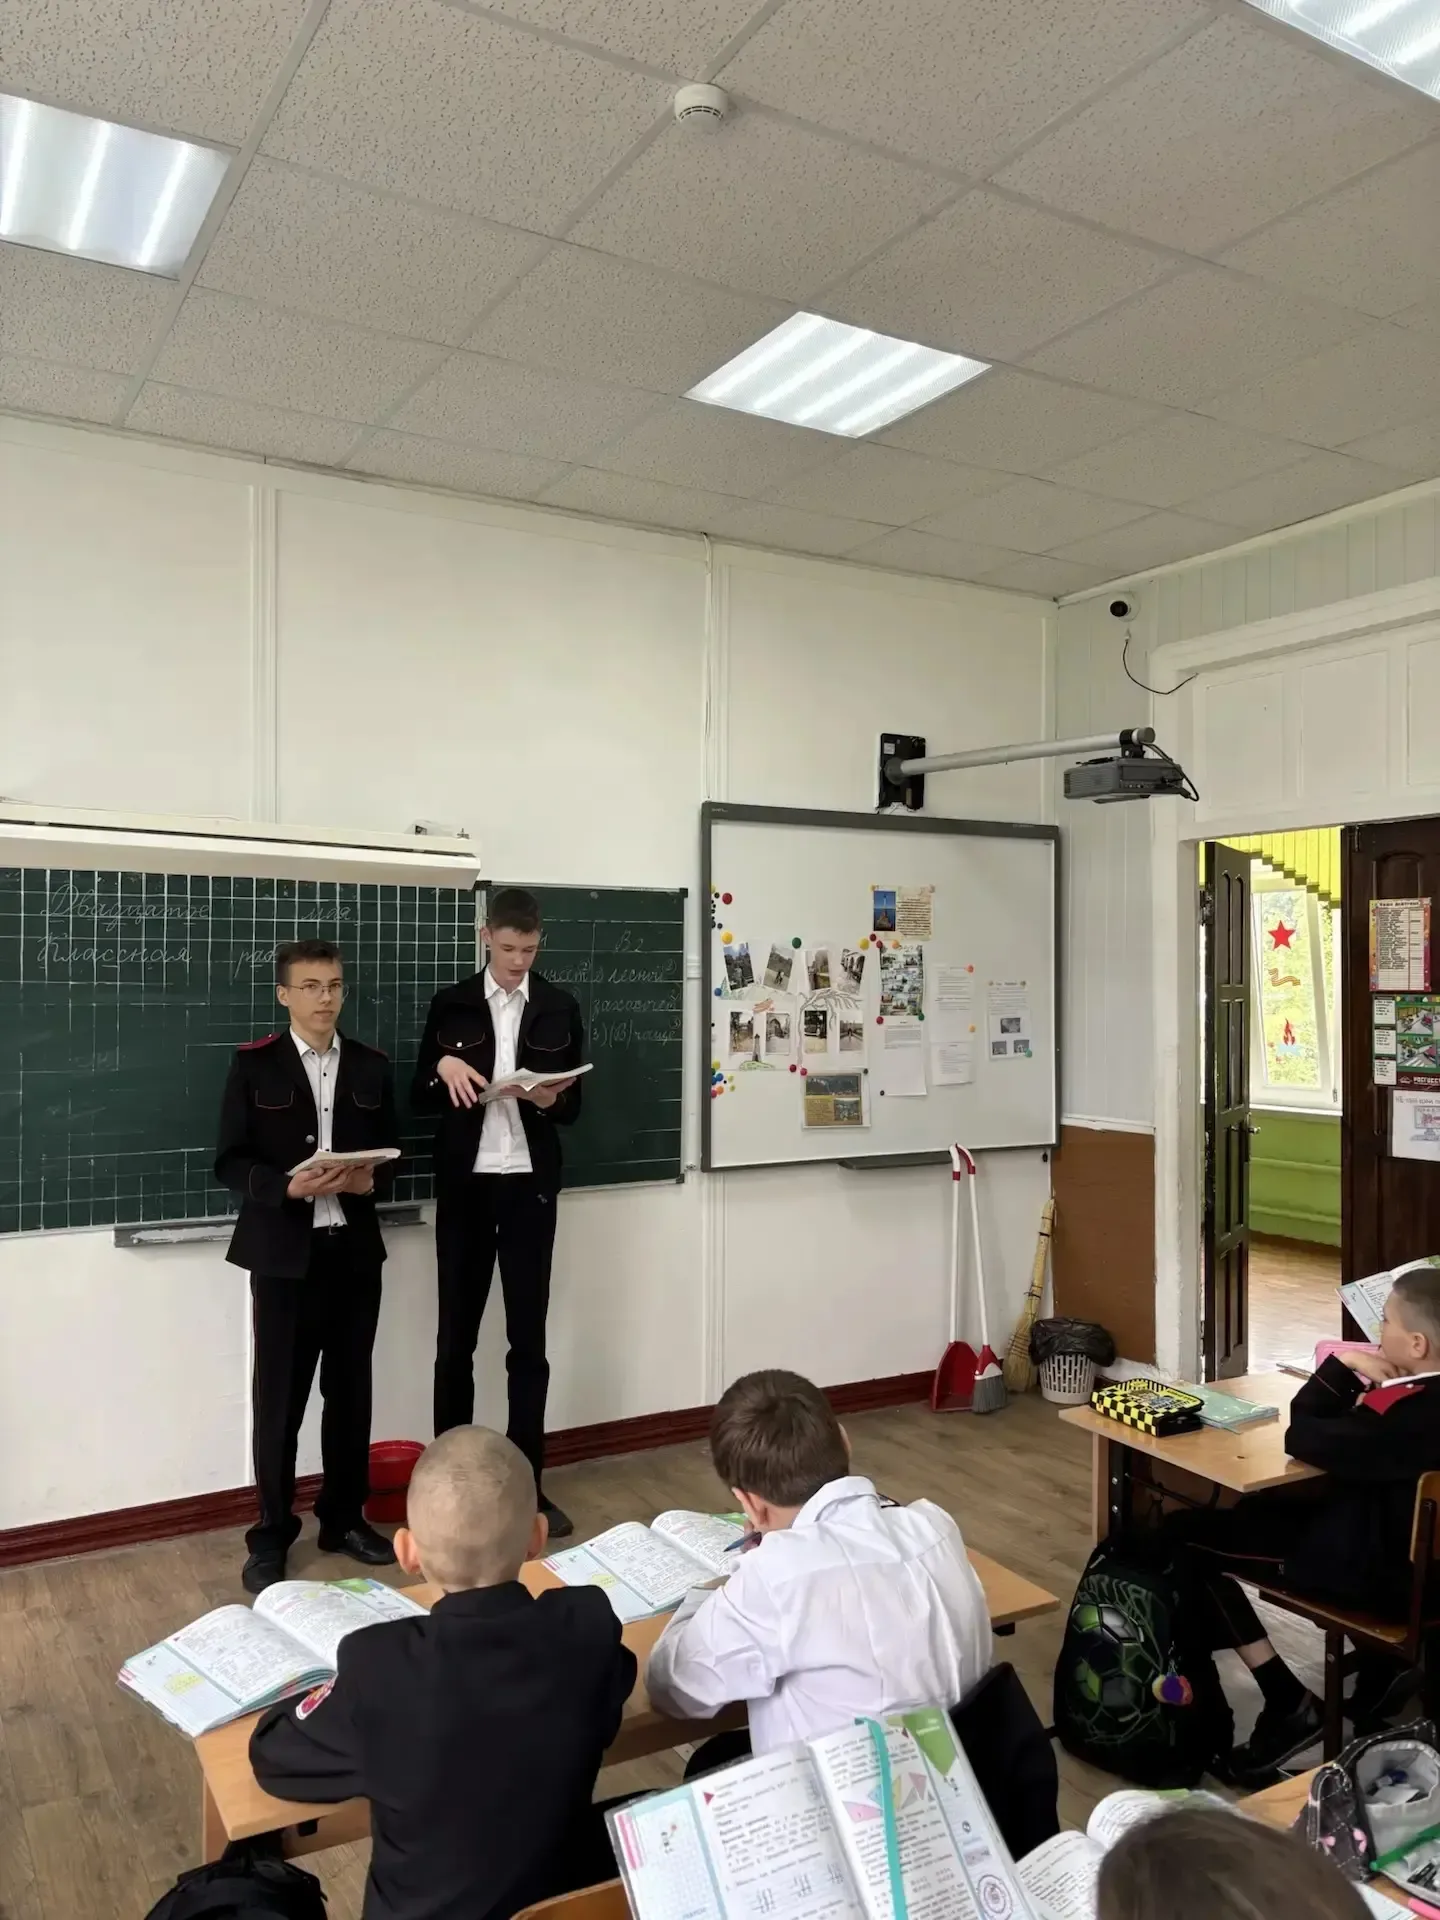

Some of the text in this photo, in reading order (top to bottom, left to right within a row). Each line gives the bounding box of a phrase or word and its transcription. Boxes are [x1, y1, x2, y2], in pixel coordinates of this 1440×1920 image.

[40, 884, 352, 932] Двадцатое мая
[37, 932, 281, 979] Классная раб
